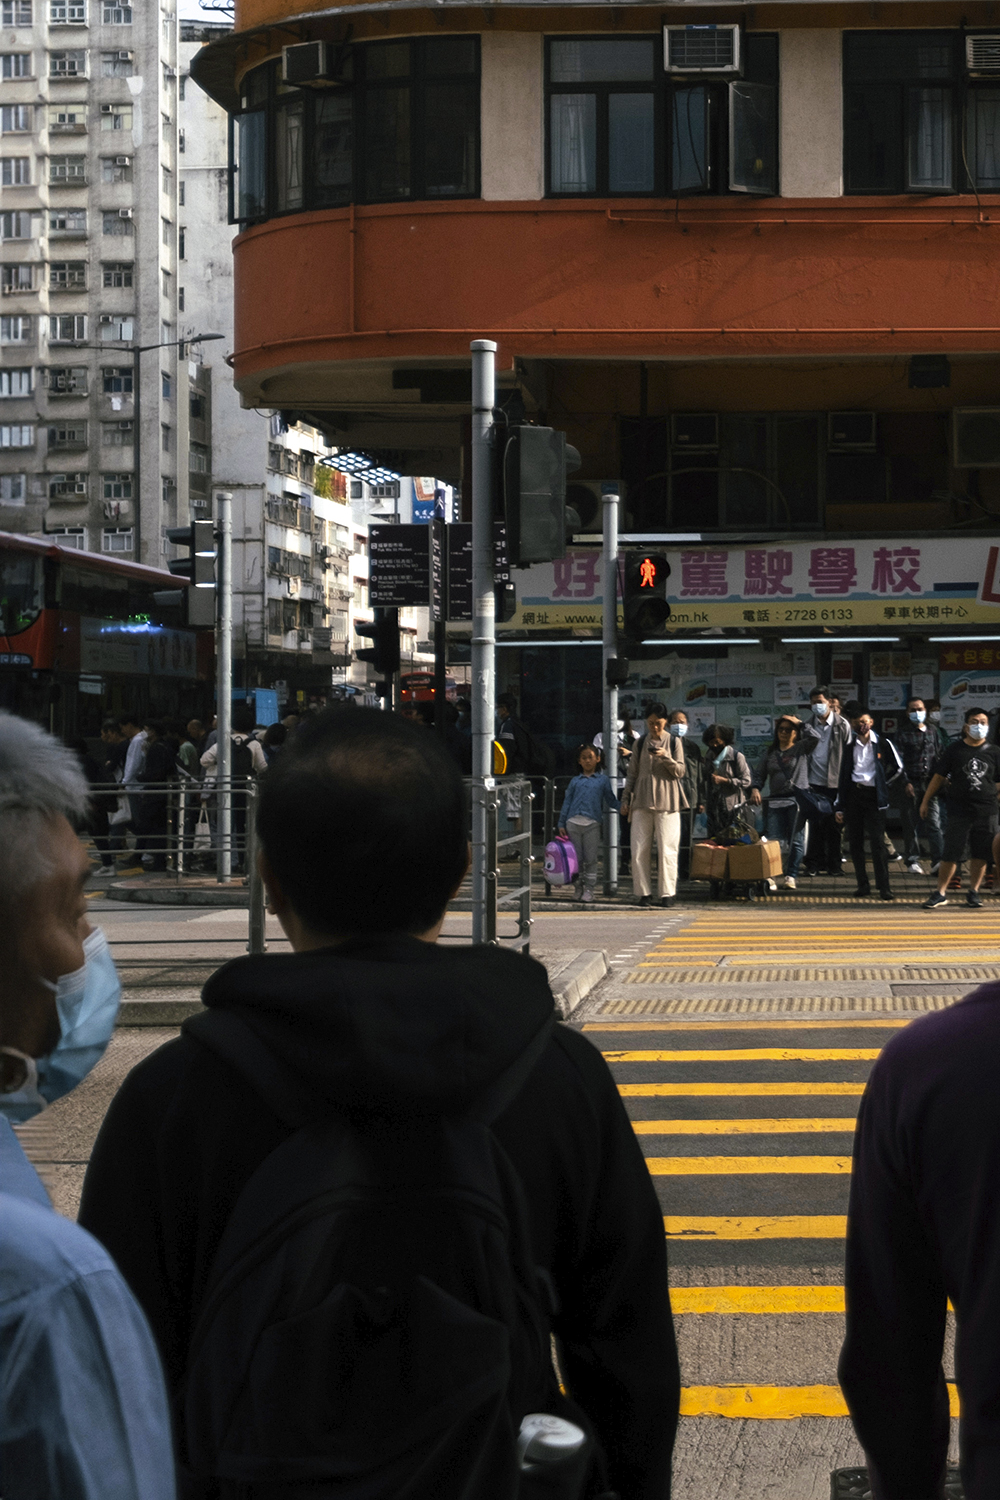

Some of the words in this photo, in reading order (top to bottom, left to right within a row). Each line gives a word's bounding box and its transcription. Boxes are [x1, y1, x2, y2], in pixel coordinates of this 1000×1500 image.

[552, 546, 921, 598] 好駕駛學校
[785, 610, 817, 622] 2728
[821, 608, 853, 621] 6133
[884, 720, 895, 732] P
